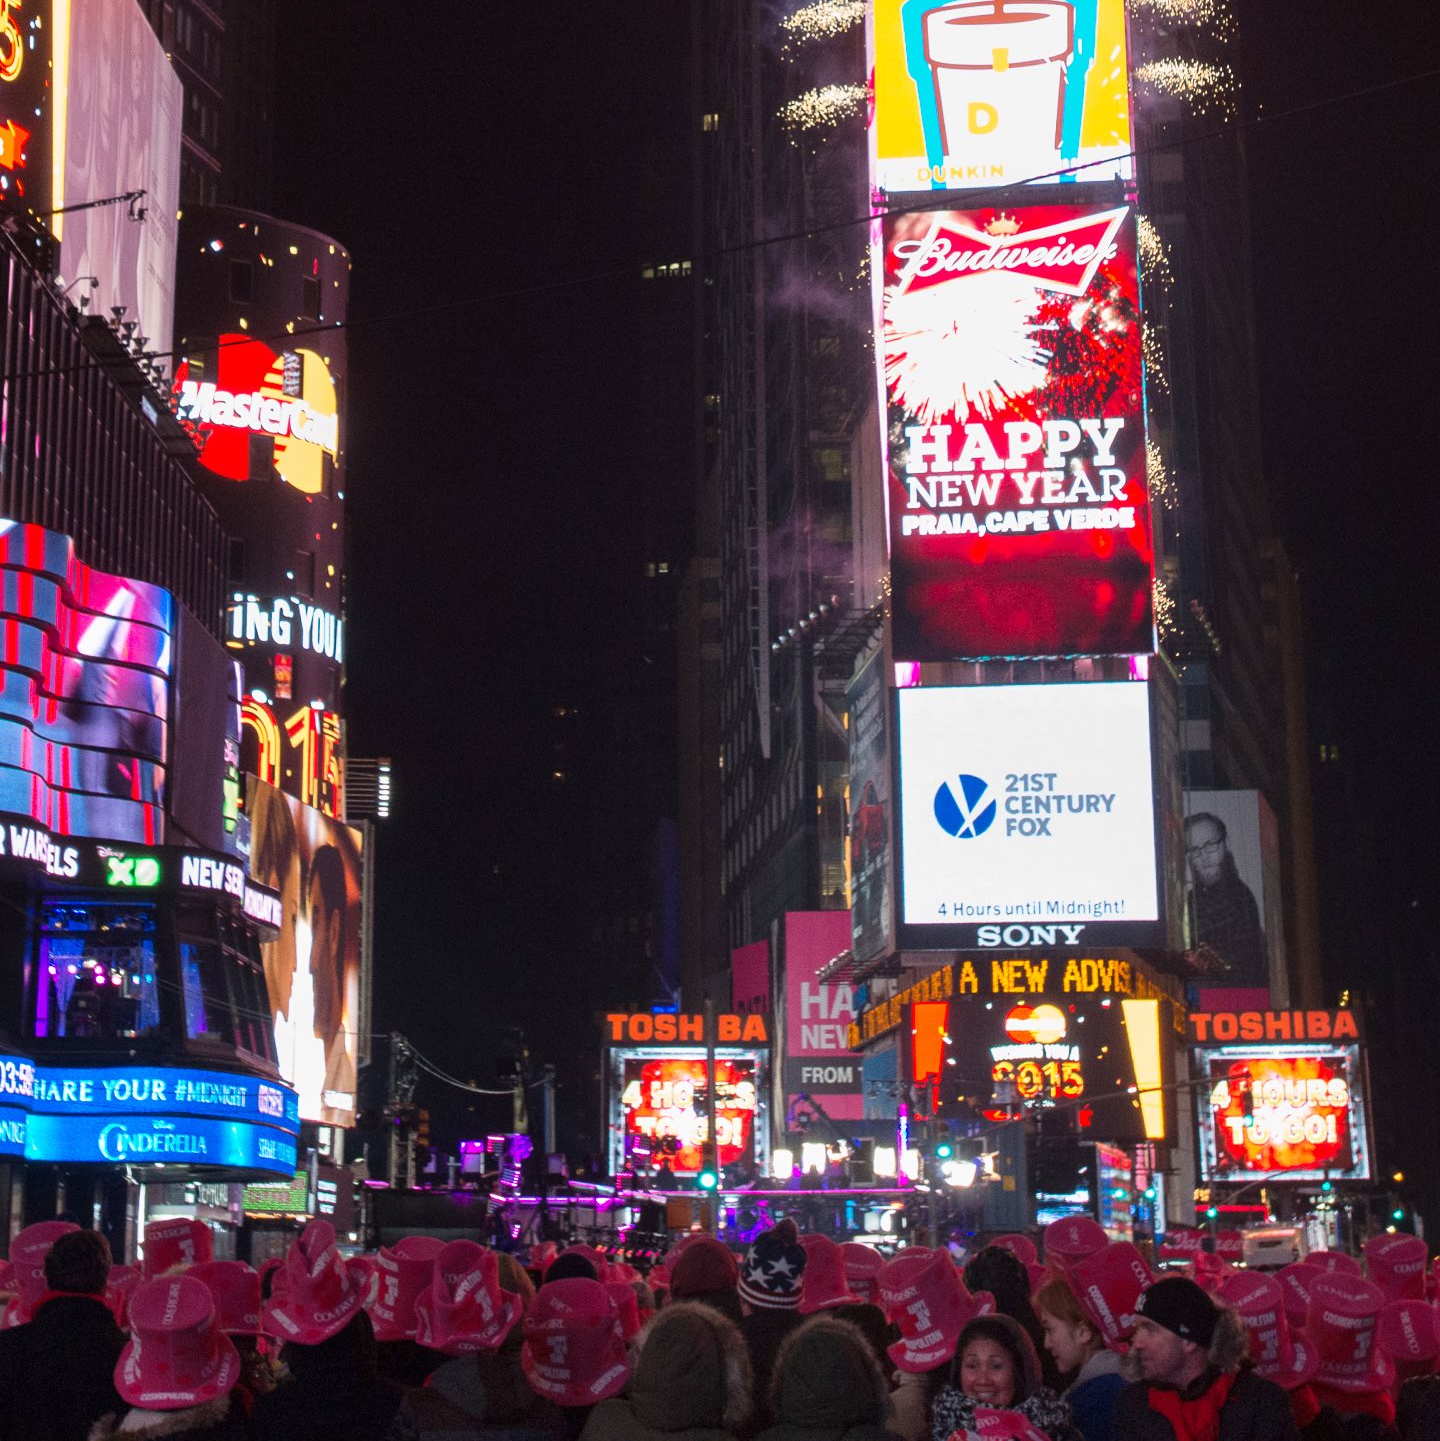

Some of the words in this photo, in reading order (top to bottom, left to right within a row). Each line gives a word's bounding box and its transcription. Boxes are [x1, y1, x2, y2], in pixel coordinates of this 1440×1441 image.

[893, 236, 1120, 279] Budweiser
[904, 417, 1125, 474] HAPPY
[906, 473, 1006, 511] NEW
[1010, 466, 1129, 505] YEAR
[1055, 506, 1136, 531] VERDE
[1005, 772, 1058, 793] 21ST
[1005, 793, 1117, 815] CENTURY
[1005, 817, 1053, 837] FOX
[181, 855, 224, 887] NEW
[937, 901, 948, 917] 4
[953, 900, 1002, 917] Hours
[1005, 900, 1042, 916] until
[1046, 899, 1127, 918] Midnight!
[977, 923, 1086, 947] SONY
[959, 960, 979, 994] A
[992, 960, 1049, 994] NEW
[607, 1014, 768, 1041] TOSHBA
[1190, 1010, 1360, 1041] TOSHIBA
[801, 1066, 854, 1083] FROM
[101, 1078, 167, 1102] YOUR
[1209, 1083, 1232, 1107] 4
[98, 1123, 208, 1161] CINDERELLA
